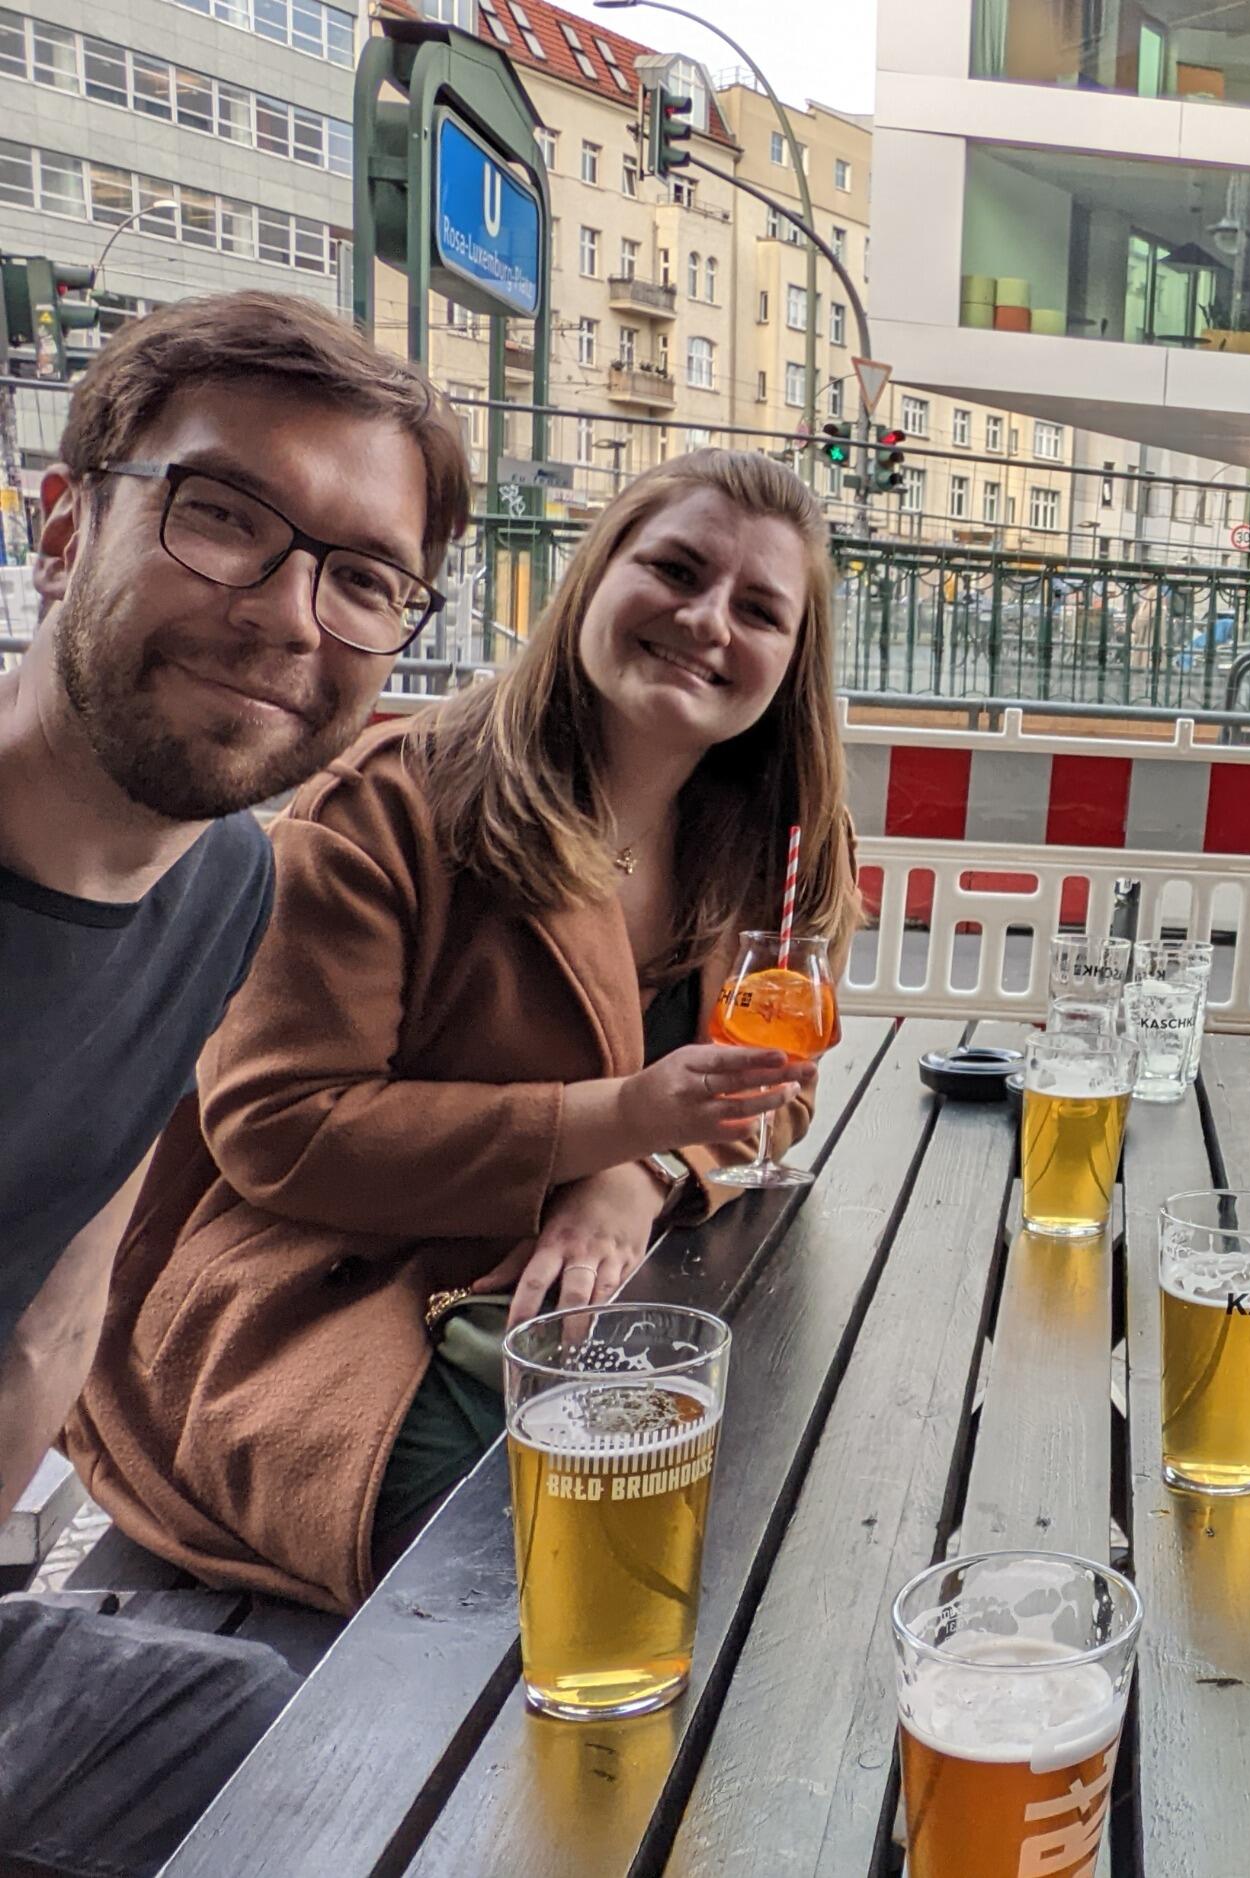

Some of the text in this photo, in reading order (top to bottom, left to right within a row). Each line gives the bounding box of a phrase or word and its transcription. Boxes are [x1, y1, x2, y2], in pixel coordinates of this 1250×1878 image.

[484, 161, 501, 238] U
[443, 216, 533, 297] Rosa-Luxemburg-Platz
[1236, 531, 1250, 544] 30
